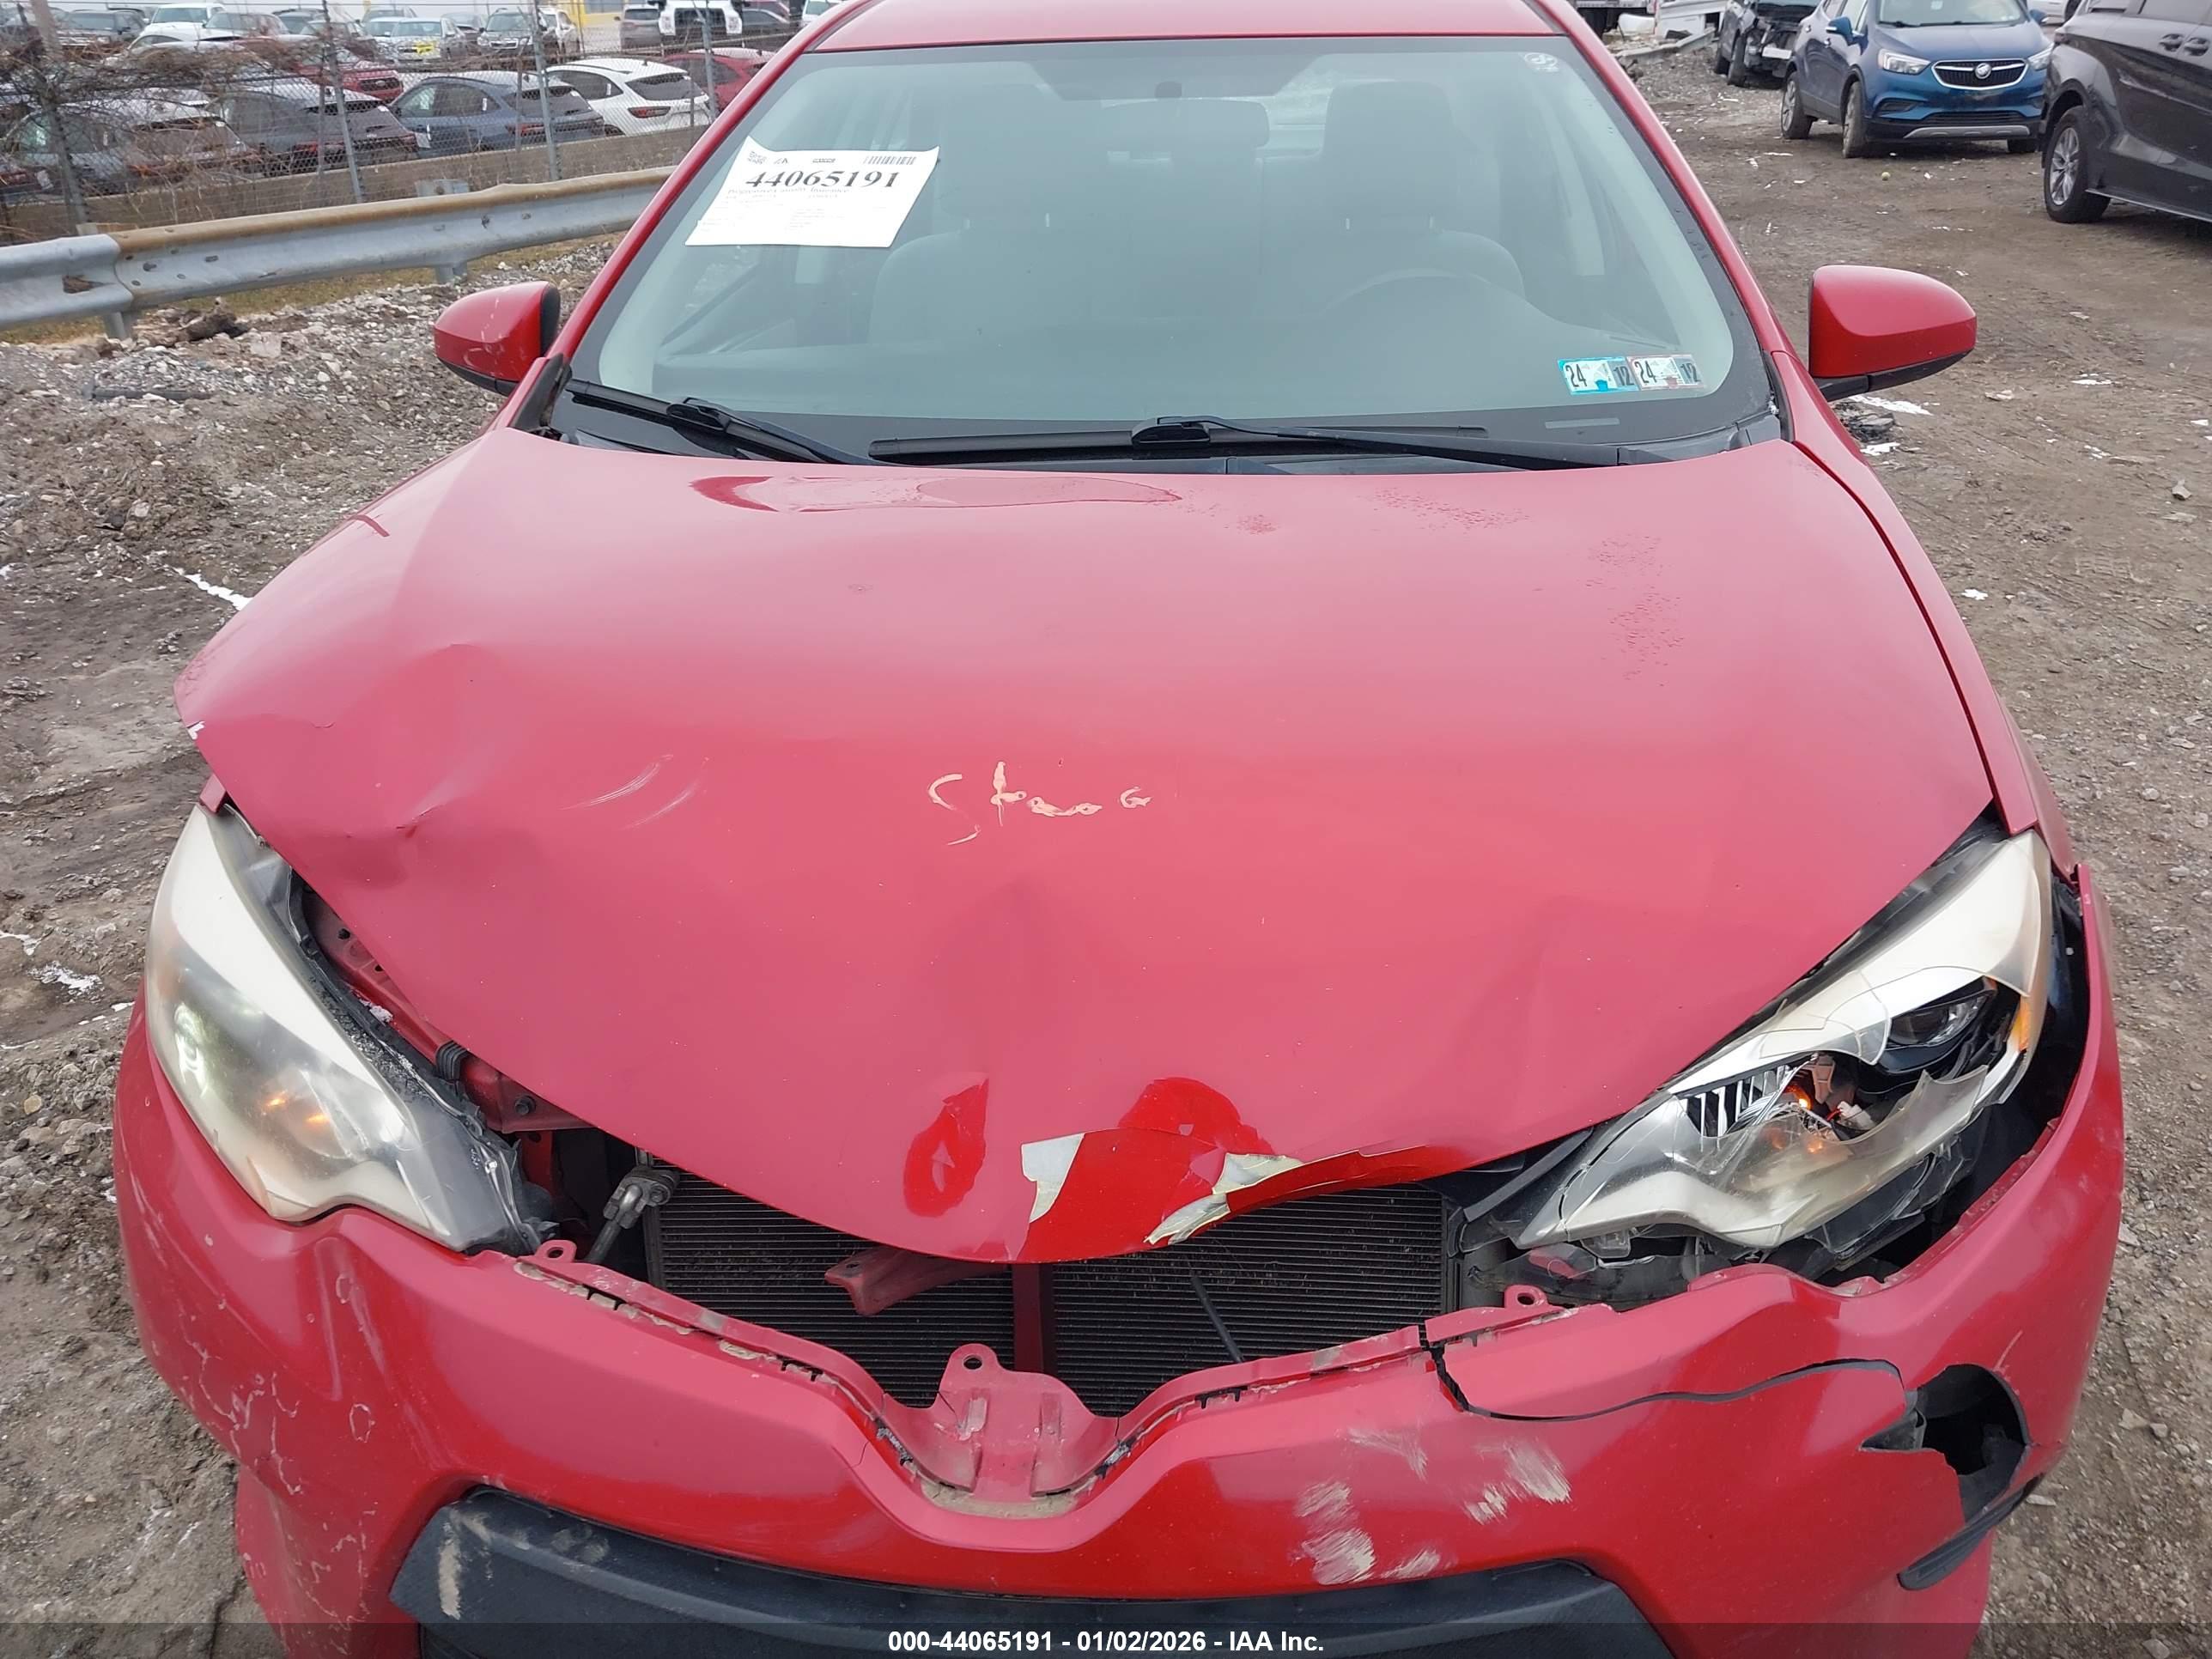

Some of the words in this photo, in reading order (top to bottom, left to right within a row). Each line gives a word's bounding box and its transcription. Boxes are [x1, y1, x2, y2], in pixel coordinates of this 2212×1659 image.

[746, 170, 899, 187] 44065191
[1565, 363, 1588, 388] 24
[1613, 366, 1635, 386] 12
[1634, 360, 1657, 384] 24
